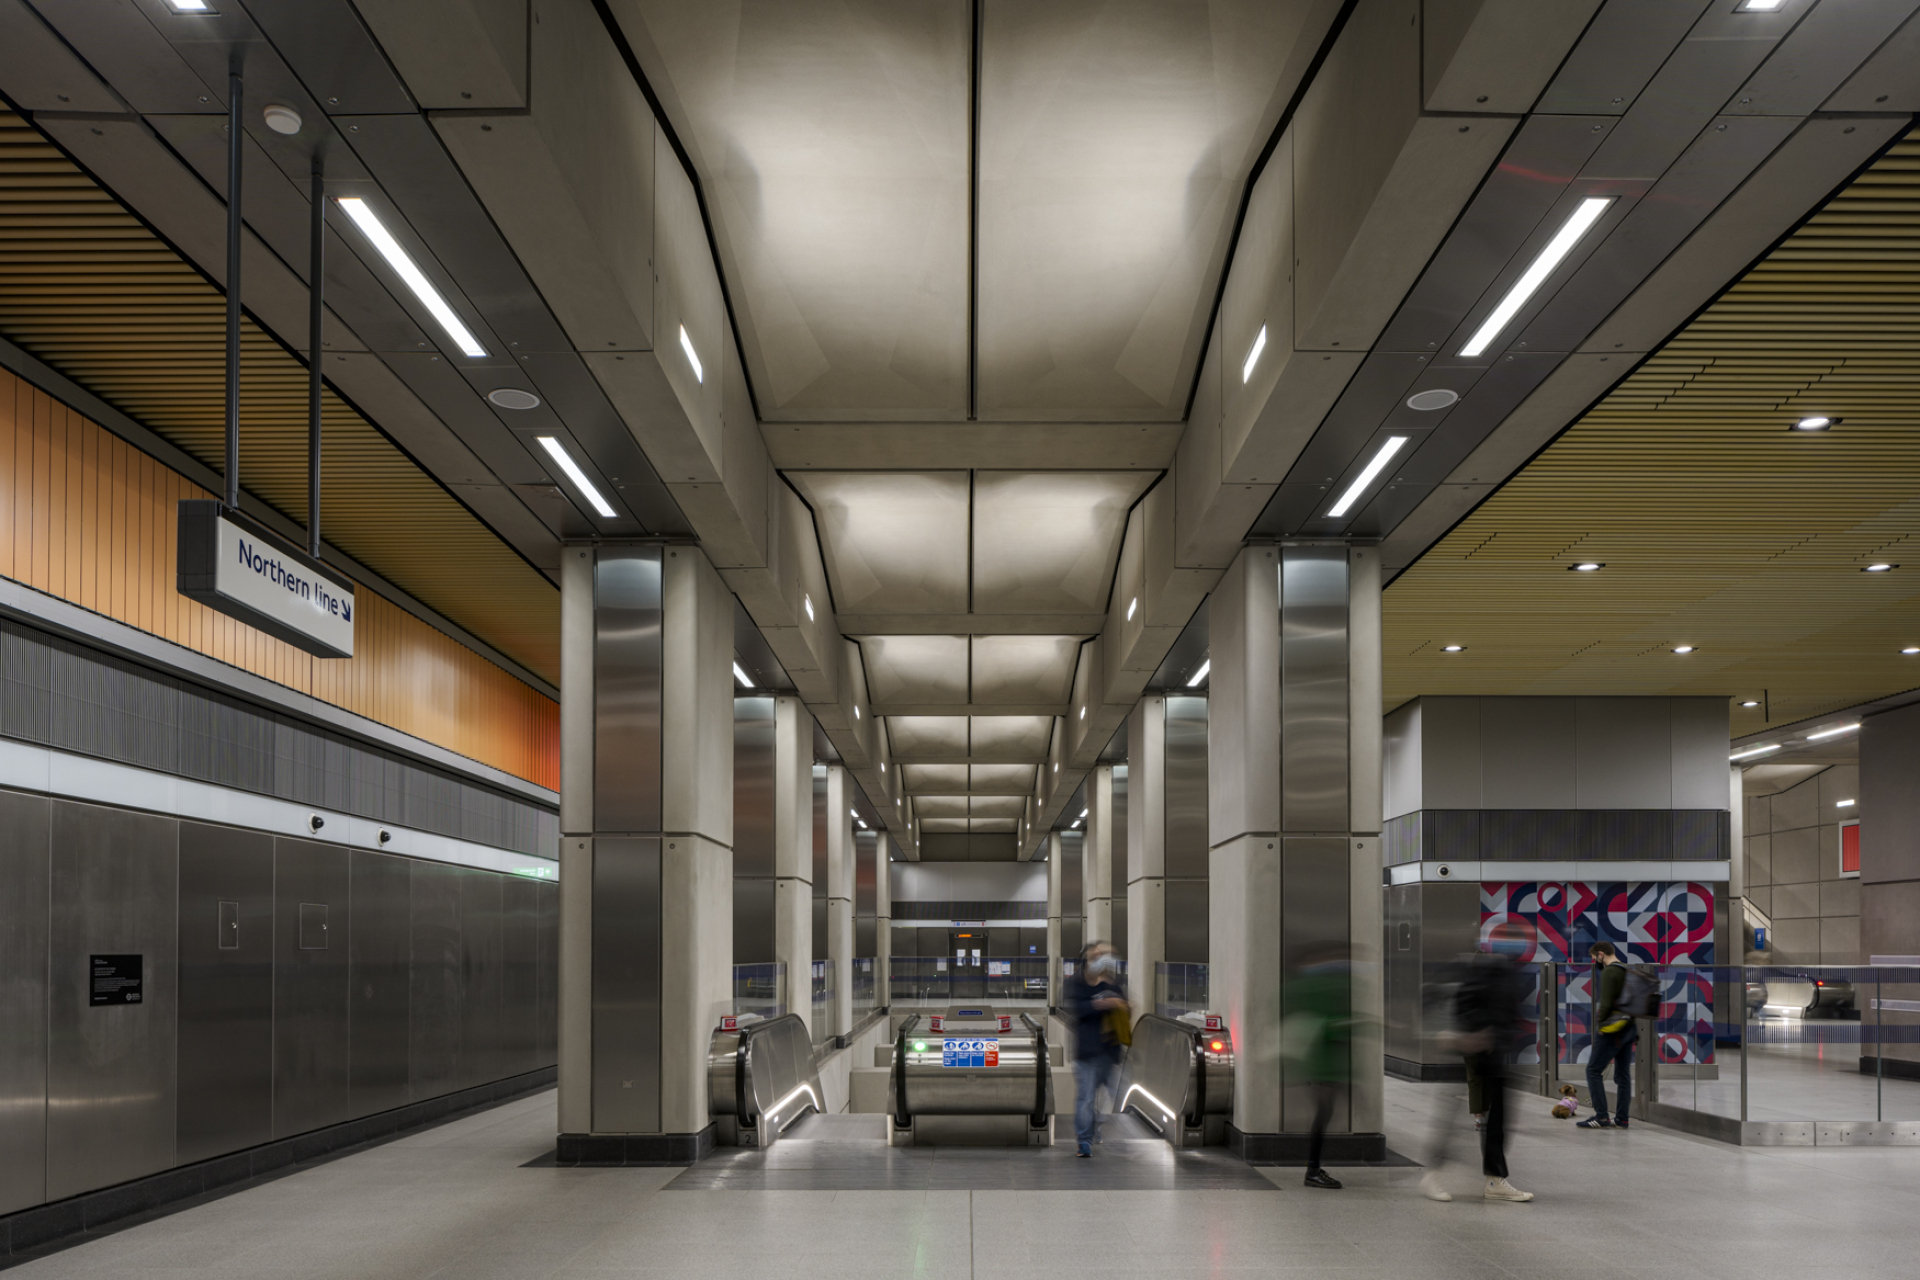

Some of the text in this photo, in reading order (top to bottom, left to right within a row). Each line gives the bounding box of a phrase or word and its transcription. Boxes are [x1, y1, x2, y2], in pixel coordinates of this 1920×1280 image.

[239, 538, 339, 615] Northern line
[745, 1134, 752, 1144] 2
